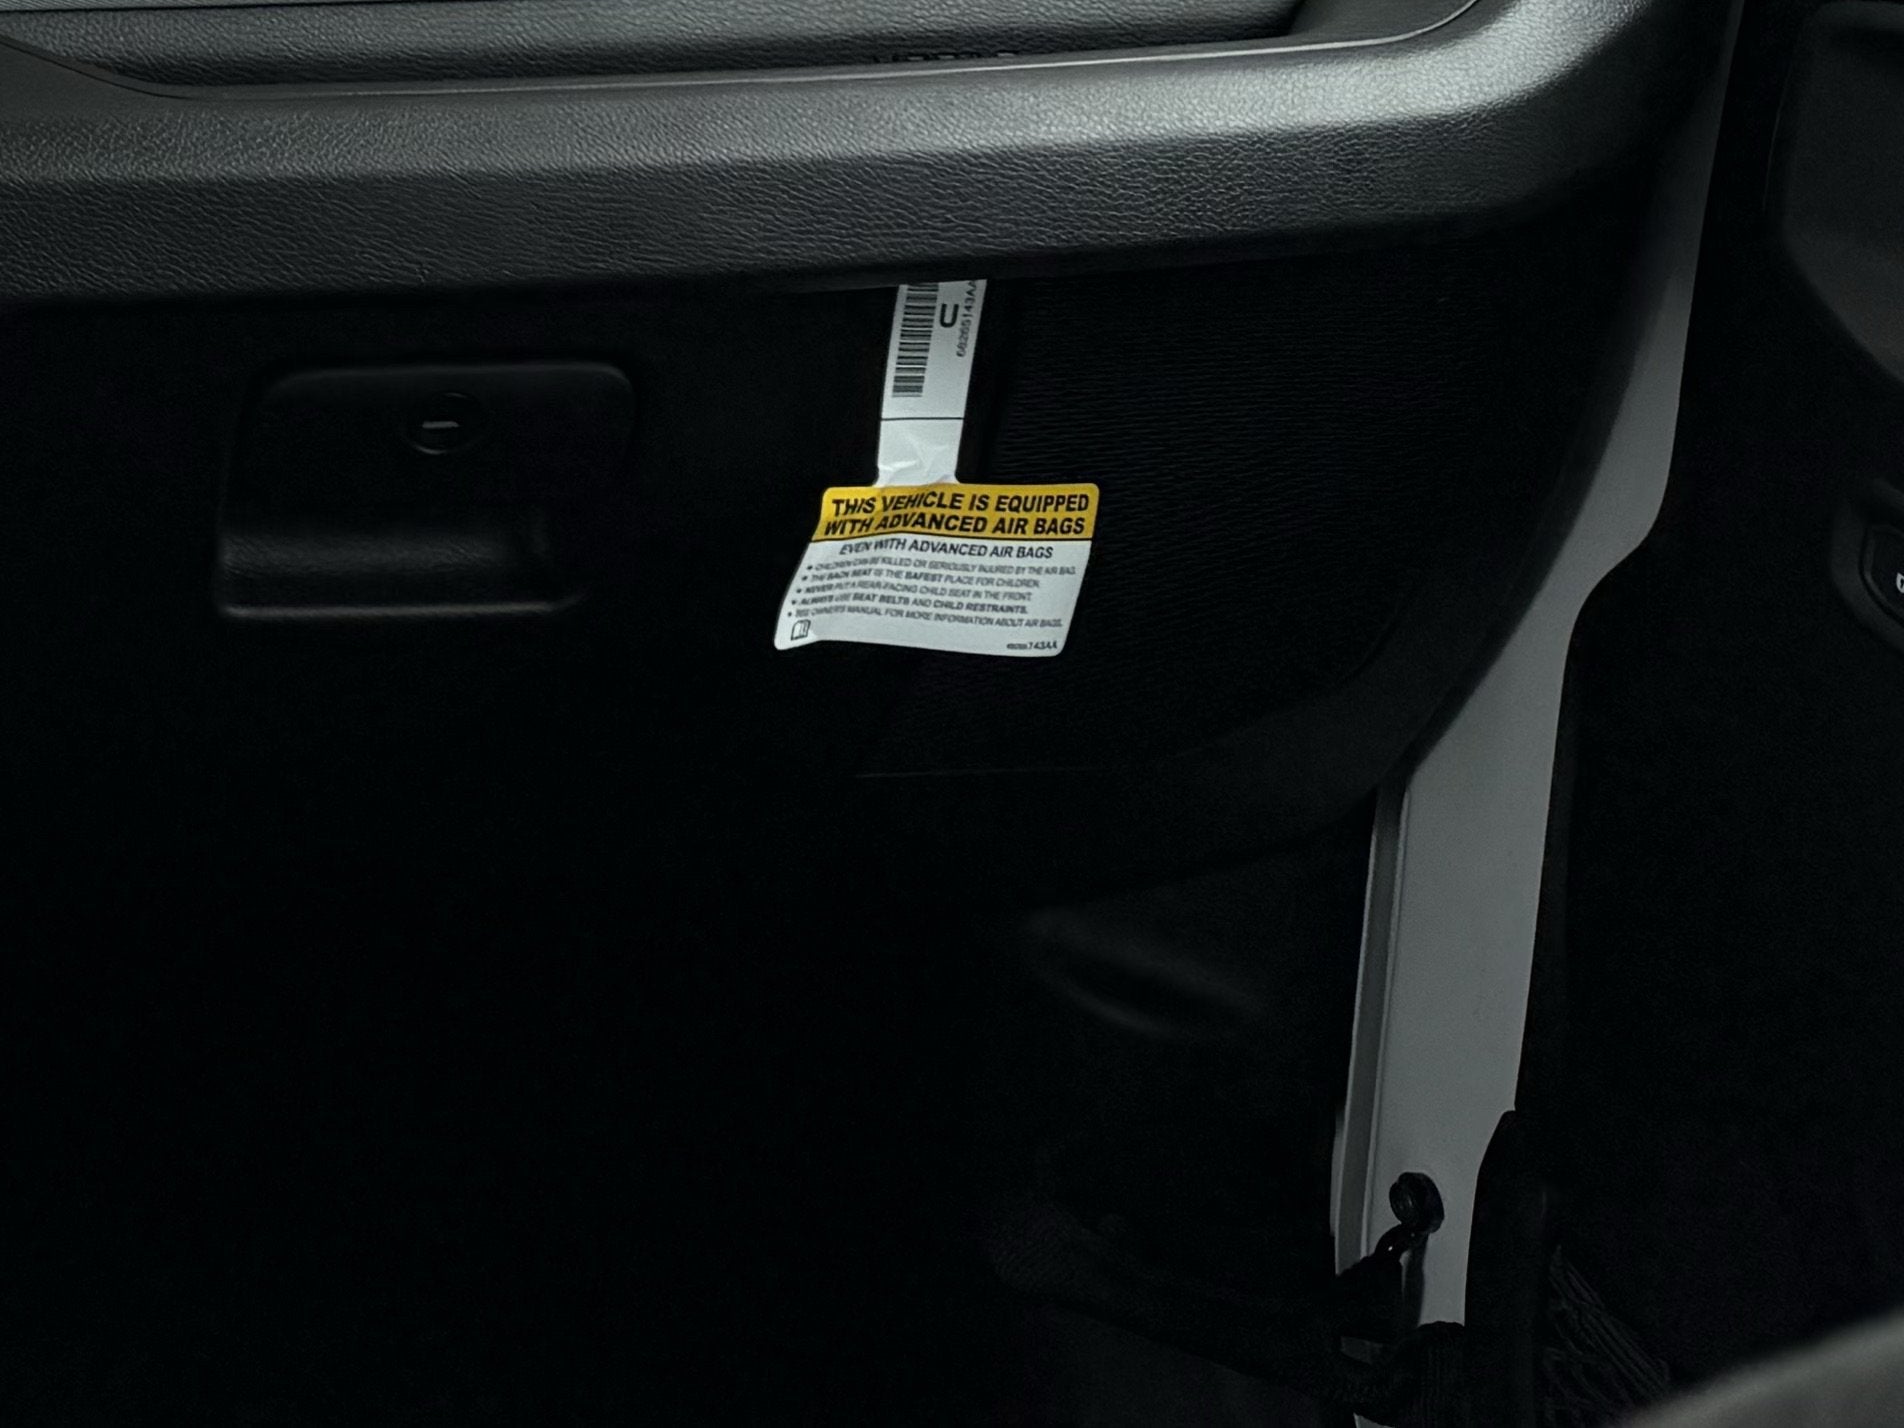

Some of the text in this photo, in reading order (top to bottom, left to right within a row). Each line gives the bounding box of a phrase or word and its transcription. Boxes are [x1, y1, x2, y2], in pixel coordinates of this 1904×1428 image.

[832, 491, 1089, 517] THIS VEHICLE IS EQUIPPED
[824, 512, 1085, 536] WITH ADVANCED AIR BAGS
[909, 540, 988, 557] ADVANCED
[990, 546, 1014, 557] AIR
[1016, 546, 1054, 559] BAGS
